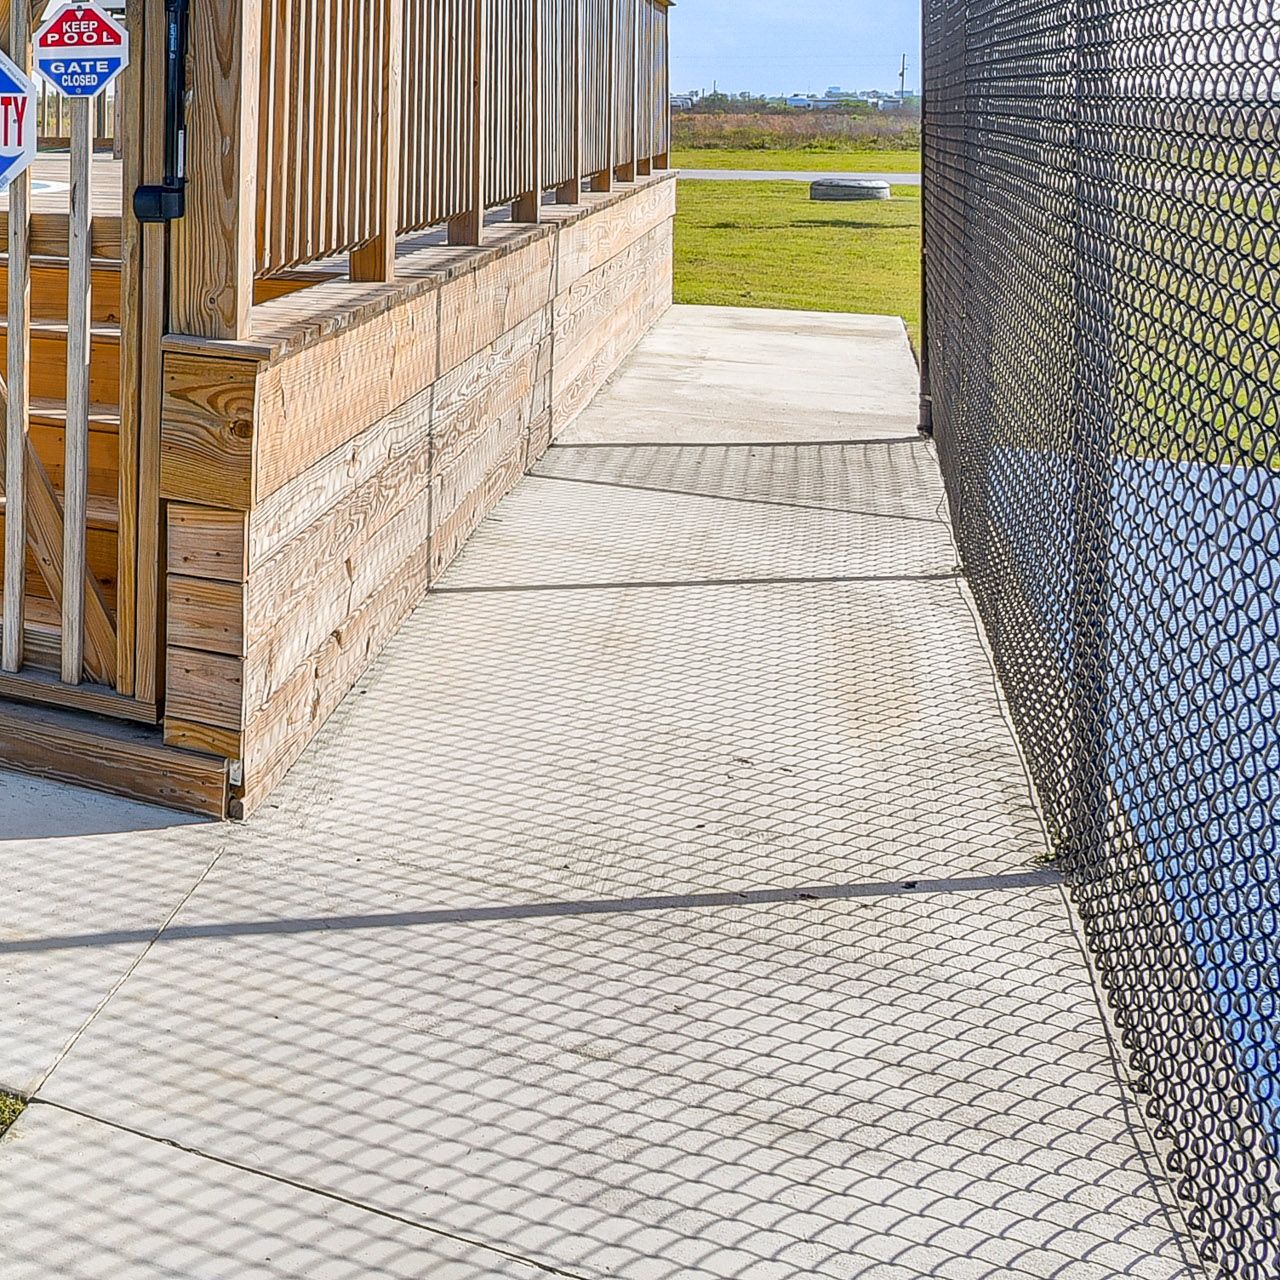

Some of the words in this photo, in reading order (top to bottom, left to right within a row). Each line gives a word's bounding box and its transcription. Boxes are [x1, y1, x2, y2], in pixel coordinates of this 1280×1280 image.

[63, 21, 98, 33] KEEP
[47, 32, 114, 44] POOL
[51, 61, 109, 73] GATE
[62, 75, 97, 86] CLOSED
